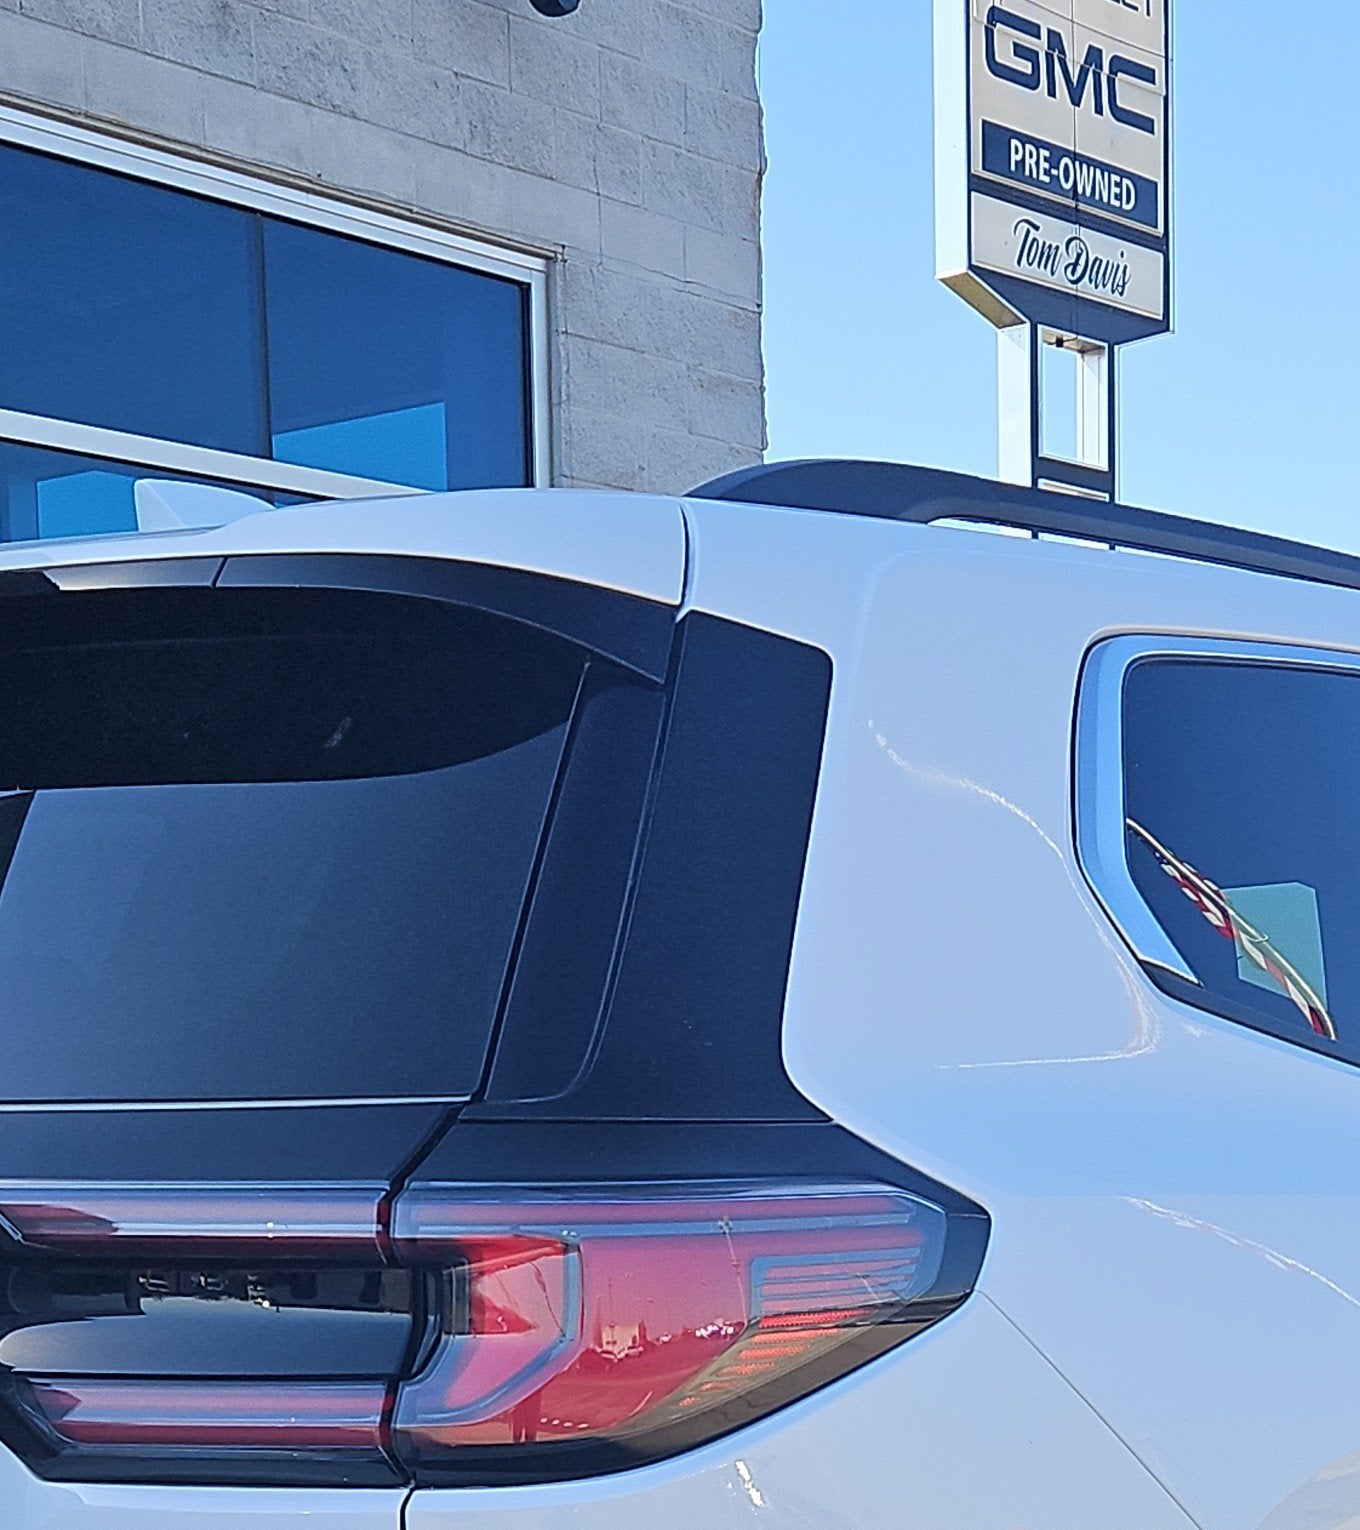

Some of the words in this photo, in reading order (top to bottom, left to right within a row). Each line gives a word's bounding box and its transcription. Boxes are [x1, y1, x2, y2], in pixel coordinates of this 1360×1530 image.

[984, 5, 1157, 136] GMC
[1010, 138, 1136, 211] PRE-OWNED
[1013, 219, 1061, 277] Tom
[1065, 236, 1132, 297] Davis
